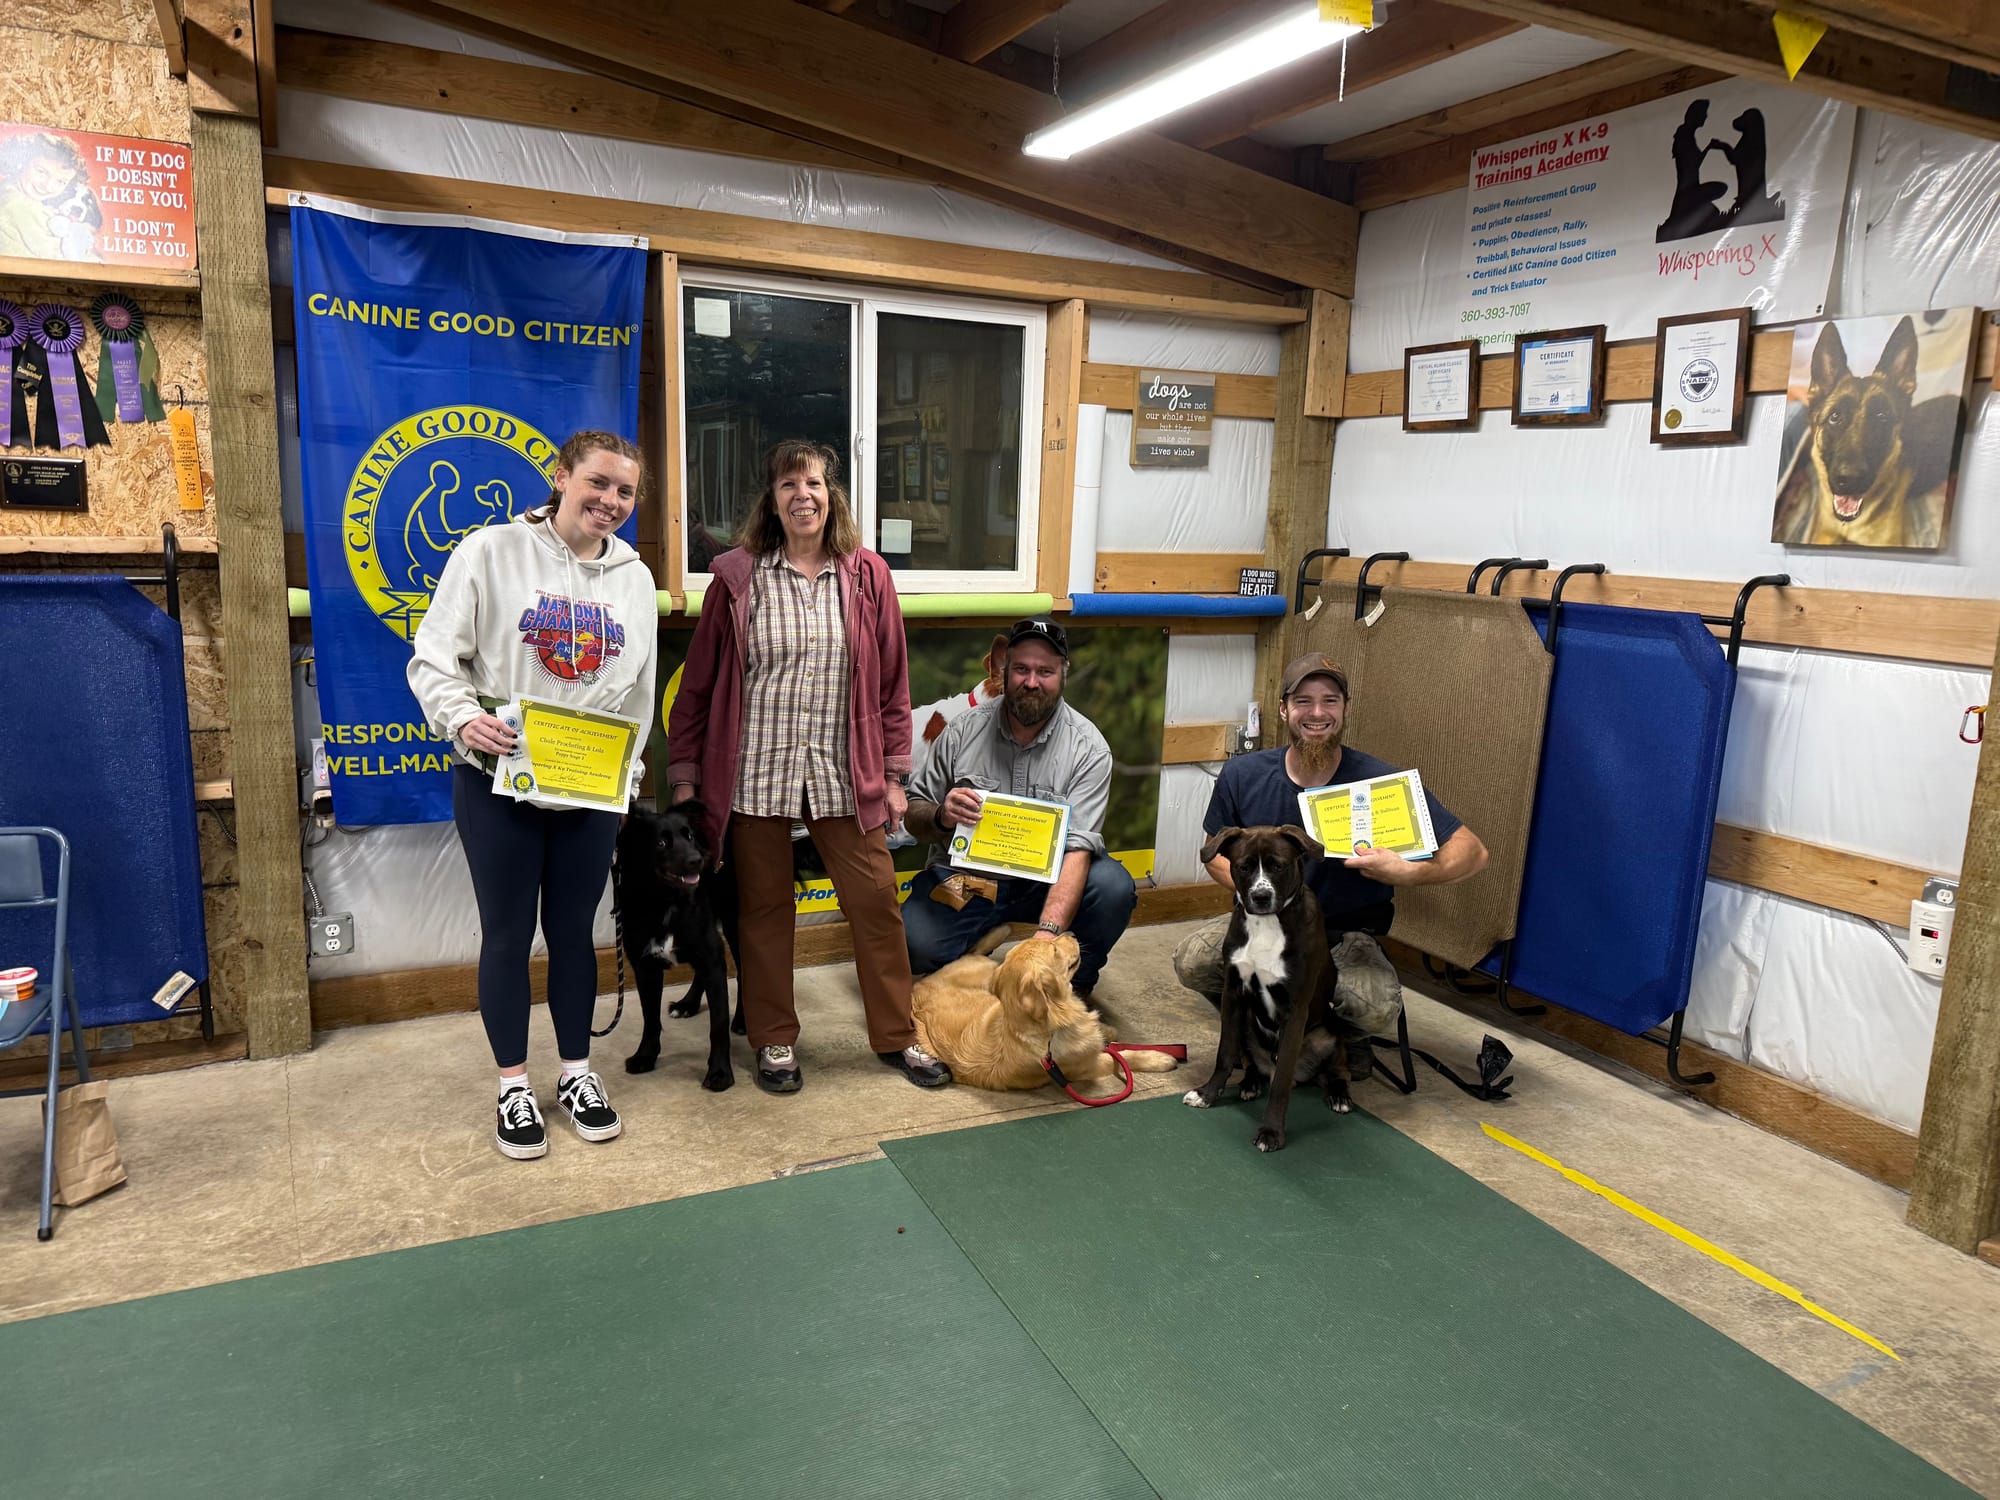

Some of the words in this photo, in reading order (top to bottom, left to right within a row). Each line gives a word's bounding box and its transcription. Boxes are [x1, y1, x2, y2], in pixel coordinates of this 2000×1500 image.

[1478, 138, 1557, 170] Whispering
[1562, 131, 1574, 148] X
[1579, 122, 1609, 144] K-9
[96, 146, 114, 162] IF
[118, 148, 148, 166] MY
[151, 152, 186, 170] DOG
[1475, 165, 1533, 189] Training
[1537, 145, 1610, 175] Academy
[106, 167, 178, 189] DOESN'T
[100, 186, 145, 205] LIKE
[148, 190, 188, 211] YOU,
[1473, 202, 1502, 215] Positive
[1503, 187, 1568, 209] Reinforcement
[1570, 182, 1597, 196] Group
[113, 218, 120, 233] I
[125, 220, 176, 238] DON'T
[1471, 222, 1487, 233] and
[1488, 216, 1512, 231] private
[1515, 209, 1552, 223] classes!
[1479, 234, 1509, 248] Puppies,
[1511, 225, 1560, 241] Obedience,
[1563, 220, 1588, 232] Rally,
[103, 236, 147, 255] LIKE
[151, 240, 190, 259] YOU.
[1476, 250, 1510, 265] Treibball,
[1511, 243, 1557, 258] Behavioral
[1560, 238, 1587, 250] Issues
[1659, 243, 1755, 280] Whispering
[1759, 233, 1777, 260] X
[1473, 265, 1507, 280] Certified
[1508, 262, 1523, 274] AKC
[1525, 258, 1558, 270] Canine
[1561, 254, 1583, 266] Good
[1586, 248, 1617, 262] Citizen
[1472, 286, 1488, 297] and
[1490, 283, 1509, 295] Trick
[1511, 278, 1548, 291] Evaluator
[308, 293, 421, 330] CANINE
[429, 311, 516, 338] GOOD
[1460, 302, 1531, 323] 360-393-7097
[1539, 350, 1575, 361] CERTIFICATE
[1149, 375, 1192, 411] dogs
[1145, 413, 1160, 421] our
[1162, 412, 1184, 422] whole
[1186, 413, 1206, 422] lives
[1178, 402, 1192, 410] are
[1194, 402, 1207, 410] not
[1157, 433, 1176, 443] make
[1177, 436, 1191, 445] our
[1159, 423, 1172, 432] but
[1175, 424, 1192, 434] they
[1150, 446, 1171, 456] lives
[1173, 447, 1195, 457] whole
[349, 430, 411, 553] CANINE
[416, 411, 517, 441] GOOD
[1242, 569, 1247, 577] A
[1247, 569, 1259, 578] DOG
[1259, 571, 1276, 579] WAGS
[1240, 582, 1274, 596] HEART
[537, 595, 614, 622] NATIONAL
[519, 608, 625, 648] CHAMPIONS
[321, 722, 452, 744] RESPONS
[533, 720, 571, 732] CERTIFICATE
[580, 729, 618, 740] ACHIEVEMENT
